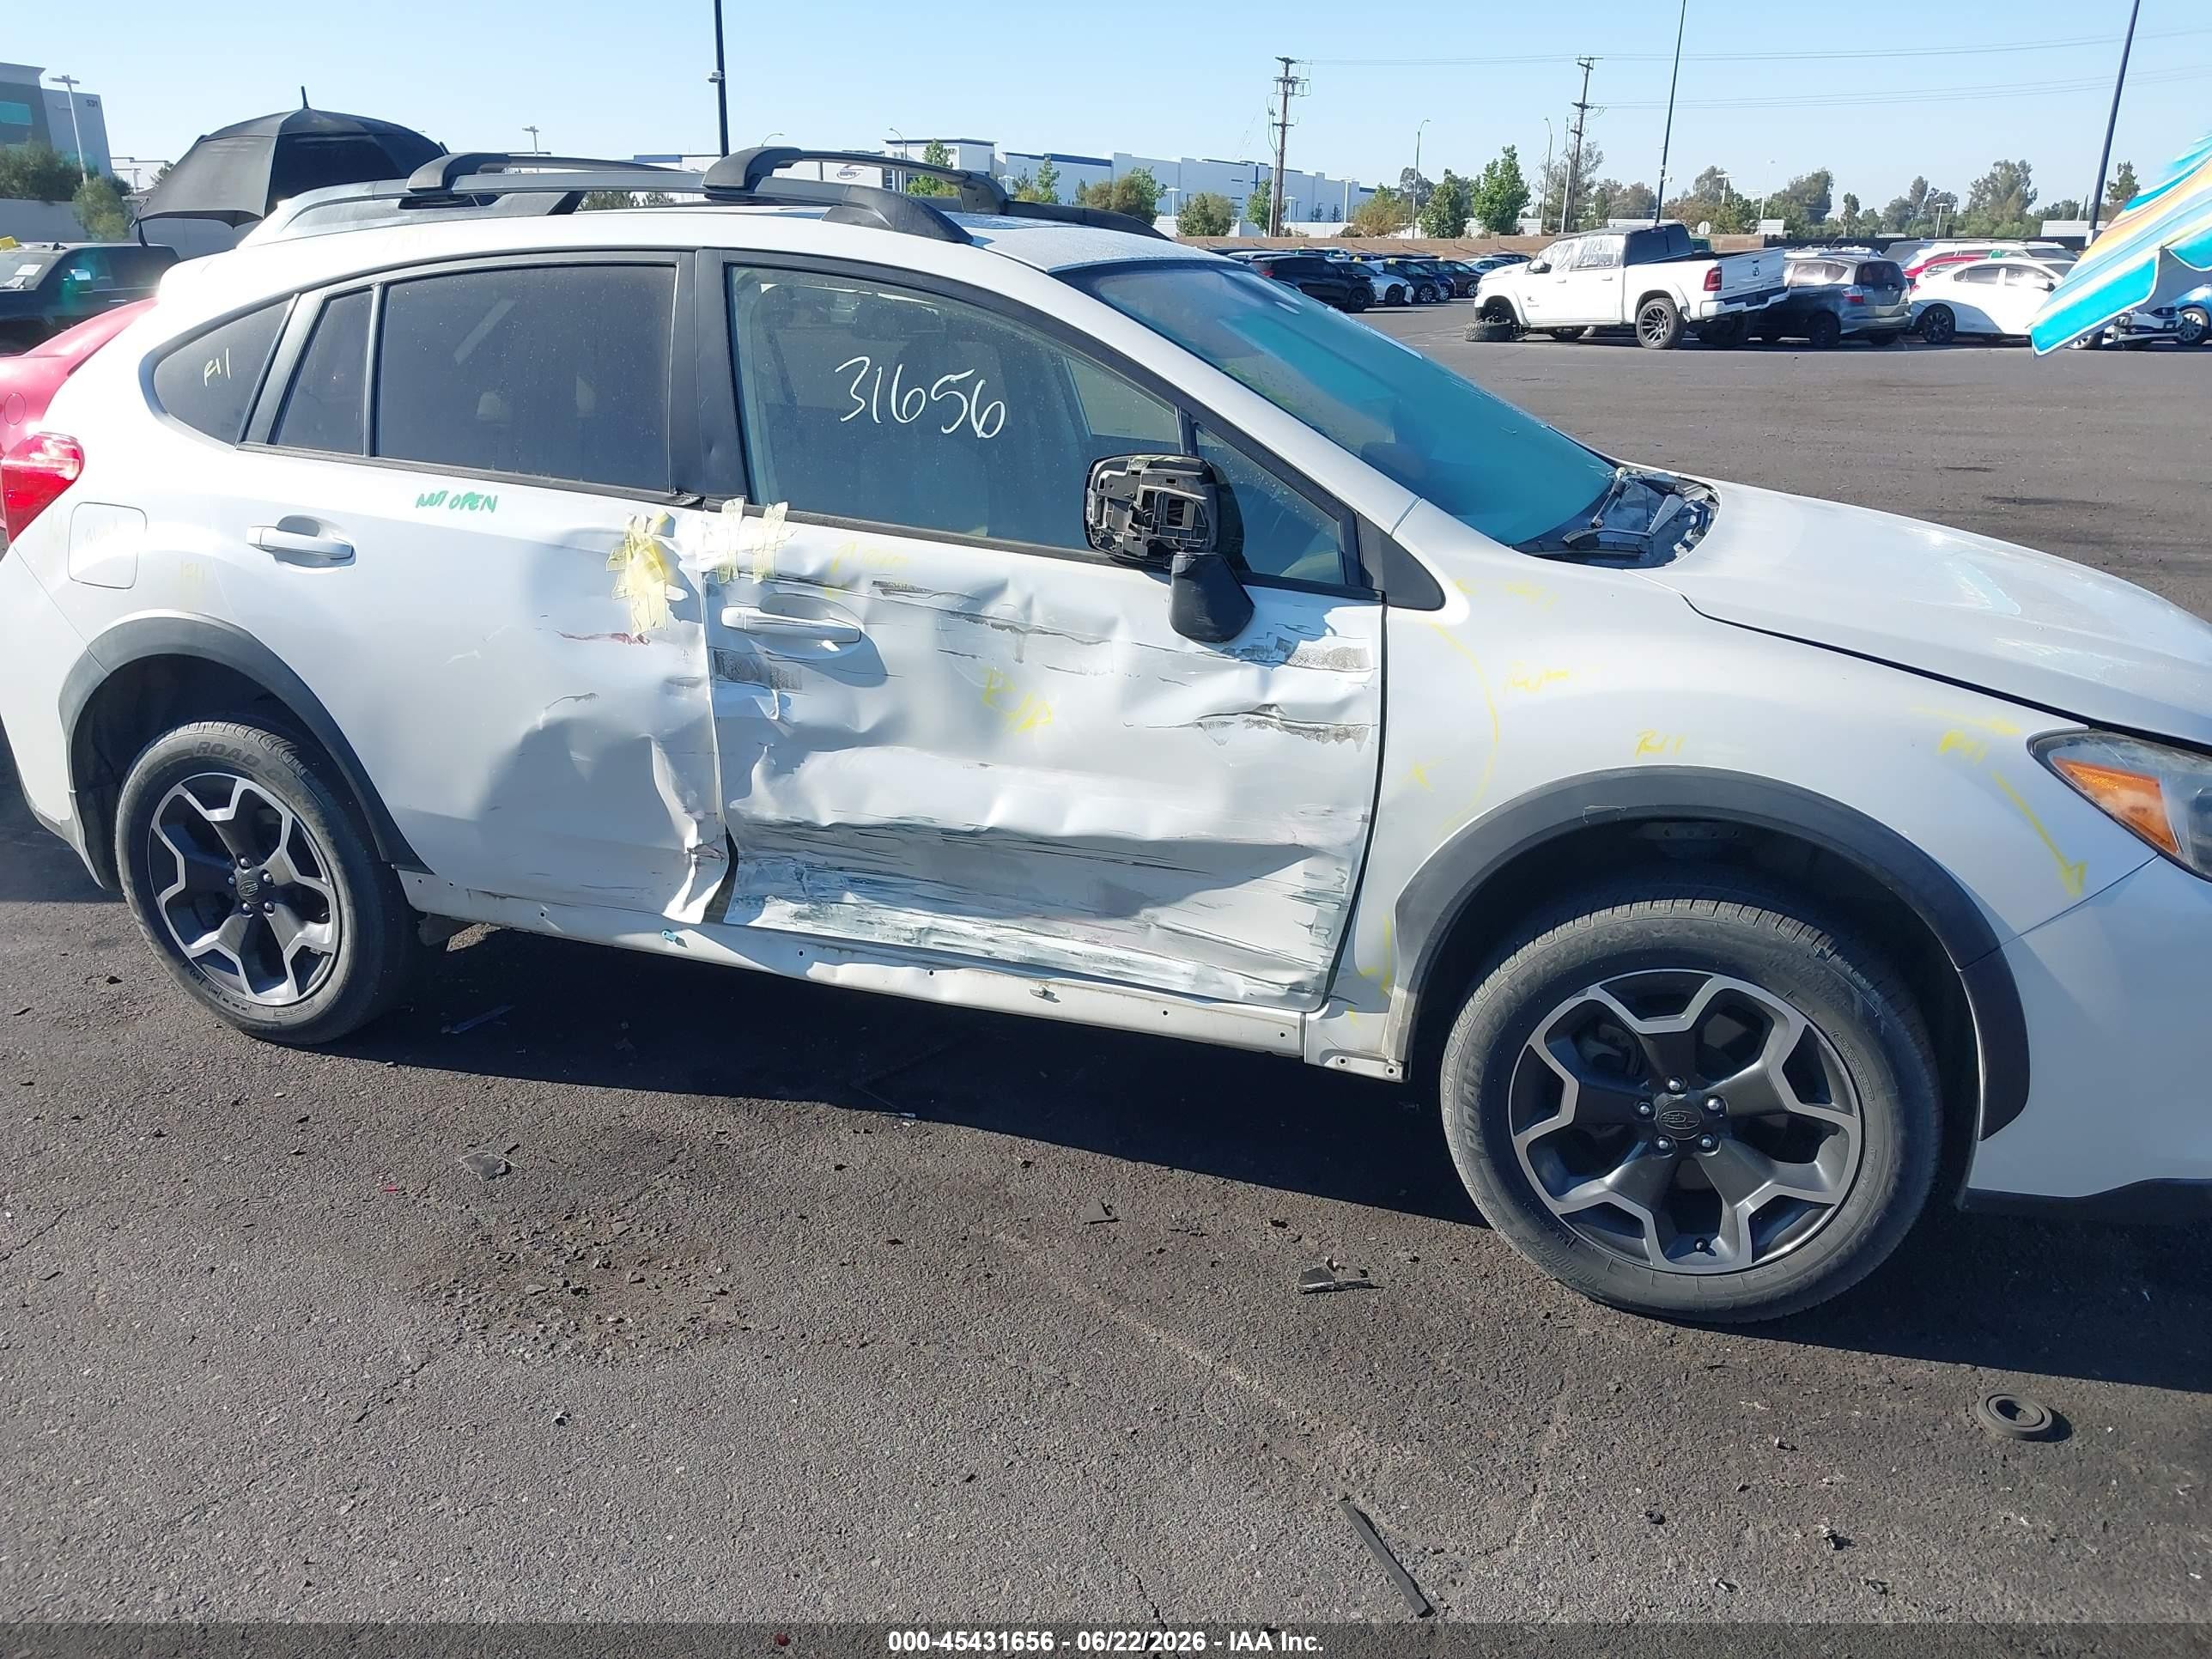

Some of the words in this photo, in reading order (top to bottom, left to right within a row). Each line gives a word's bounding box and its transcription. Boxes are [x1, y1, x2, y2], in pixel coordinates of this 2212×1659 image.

[835, 356, 1006, 439] 31656
[448, 491, 498, 514] OPEN
[197, 741, 261, 767] ROAD
[1462, 1055, 1486, 1153] ROAD
